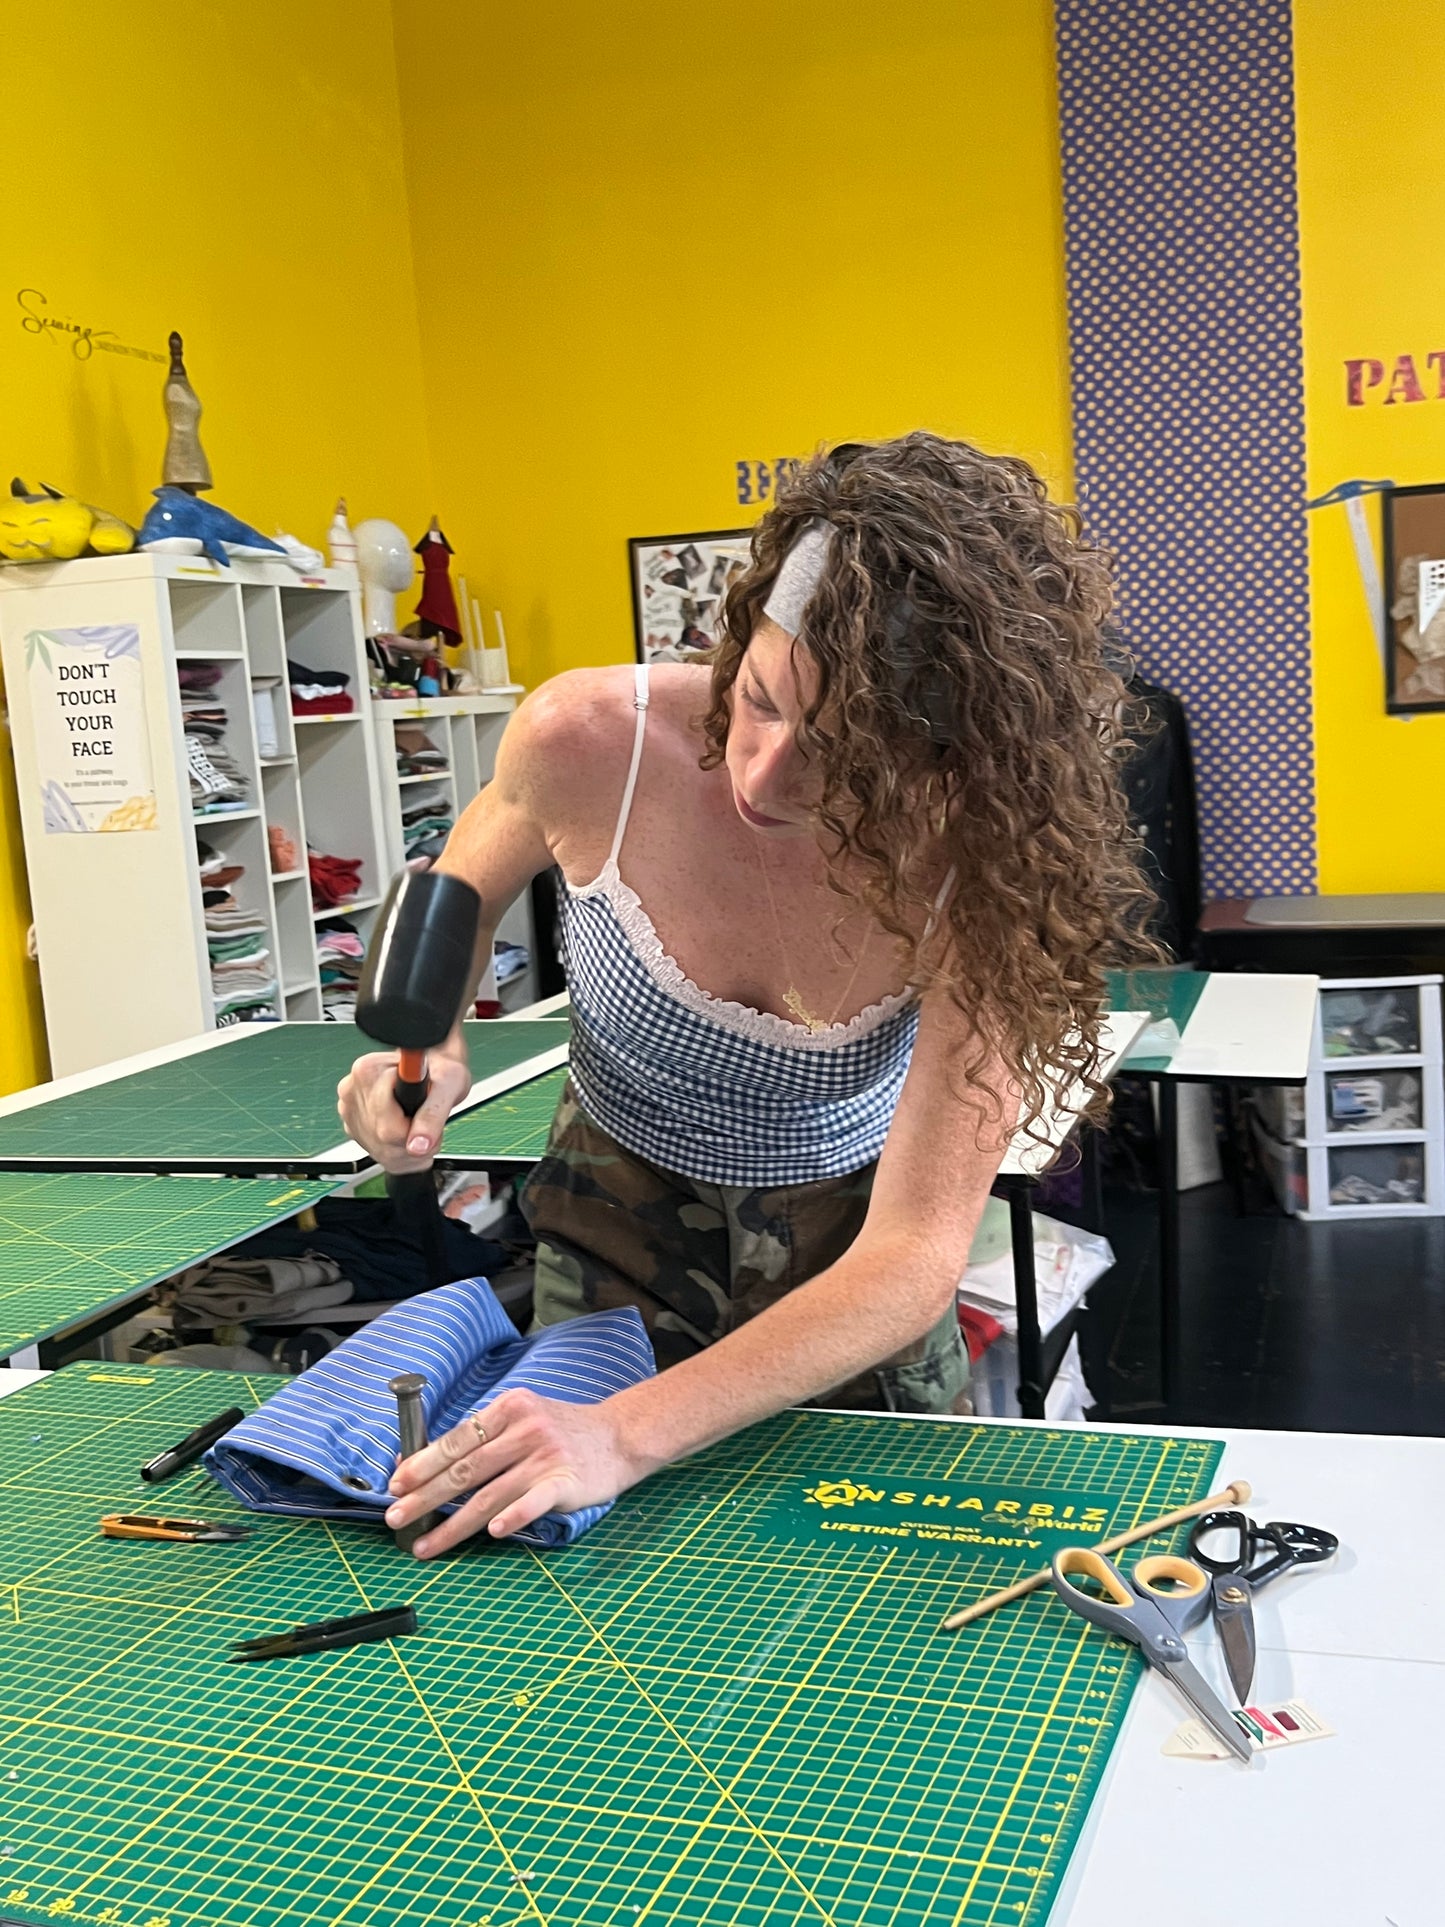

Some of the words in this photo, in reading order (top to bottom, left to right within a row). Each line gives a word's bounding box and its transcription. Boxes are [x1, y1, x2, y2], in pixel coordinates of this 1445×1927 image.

[58, 664, 110, 681] DON'T
[57, 689, 117, 706] TOUCH
[65, 715, 114, 731] YOUR
[72, 741, 113, 757] FACE
[900, 1521, 952, 1531] CUTTING
[1037, 1518, 1102, 1532] World
[820, 1521, 912, 1537] LIFETIME
[916, 1529, 1043, 1549] WARRANTY
